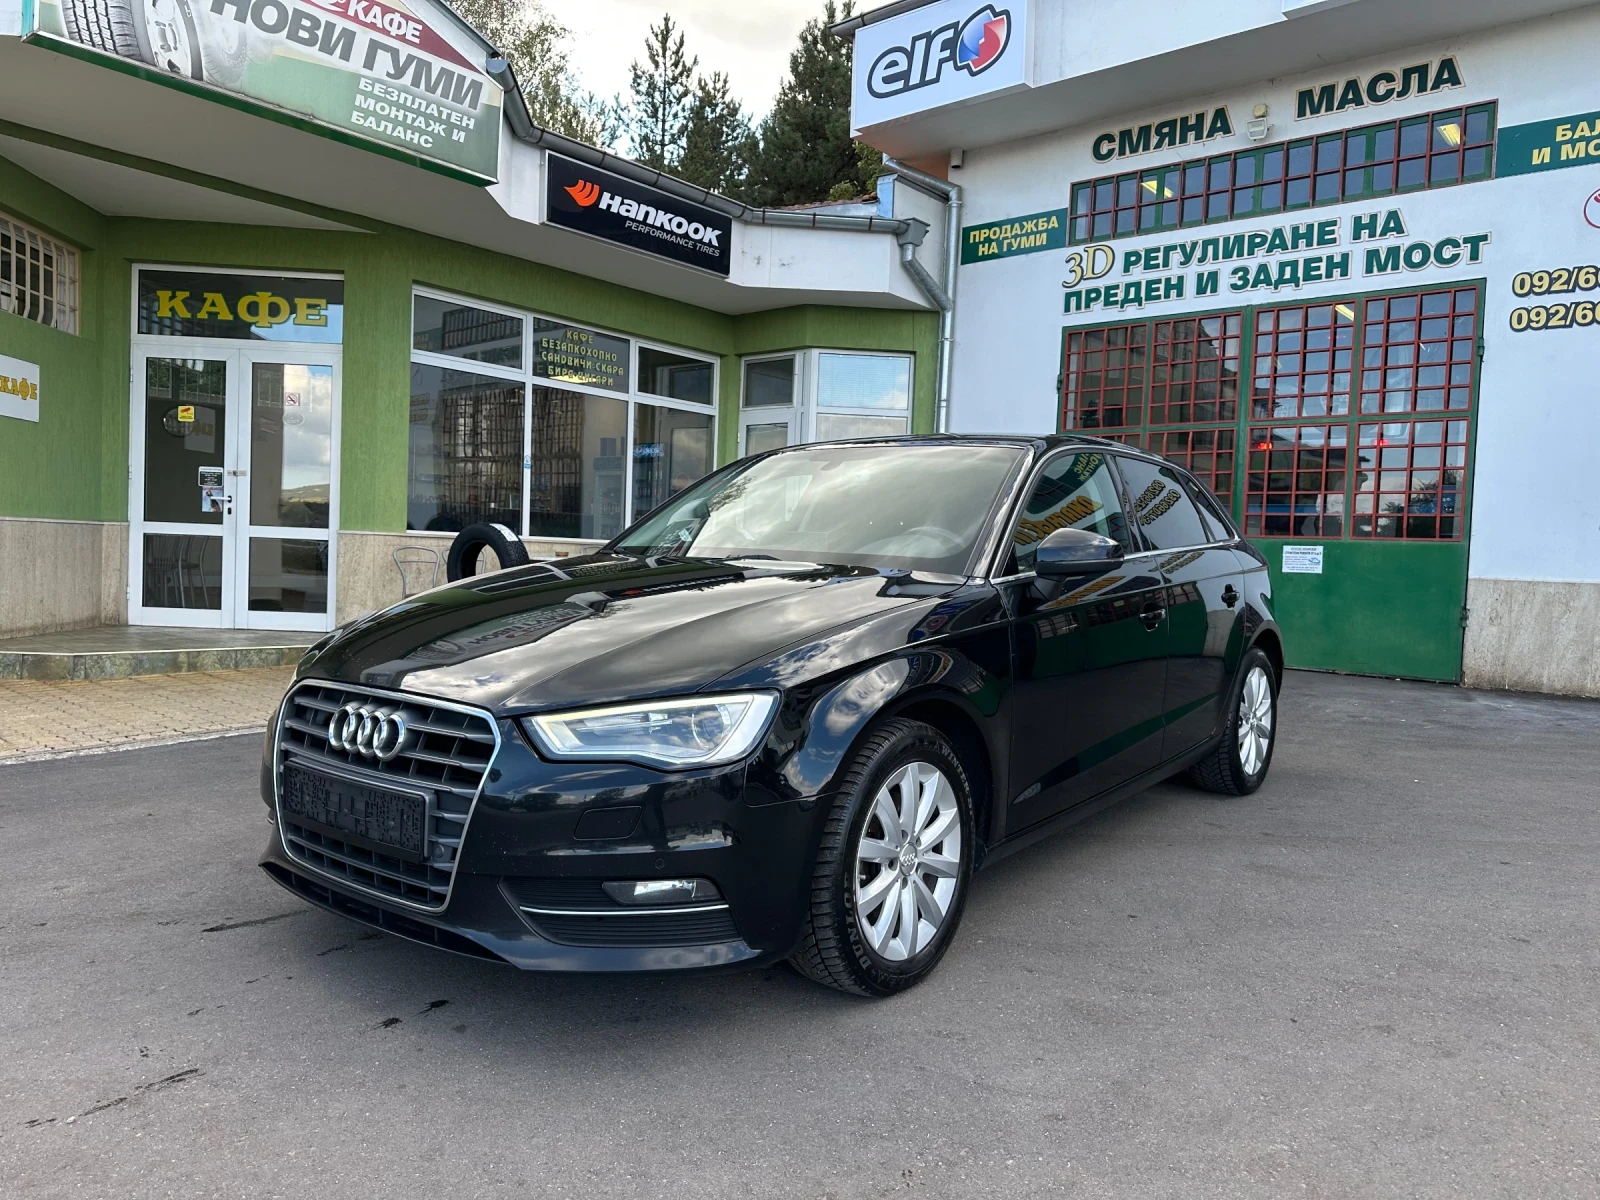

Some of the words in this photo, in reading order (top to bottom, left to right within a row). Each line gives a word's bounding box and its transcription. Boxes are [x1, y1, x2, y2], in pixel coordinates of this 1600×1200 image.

[347, 0, 423, 44] КАФЕ
[362, 38, 483, 111] ГУМИ
[867, 21, 960, 98] elf
[354, 93, 446, 137] МОНТАЖ
[452, 128, 466, 144] И
[358, 77, 475, 130] БЕЗПЛАТЕН
[1092, 106, 1234, 162] СМЯНА
[1296, 56, 1464, 120] МАСЛА
[350, 110, 433, 149] БАЛАНС
[1531, 146, 1551, 165] И
[625, 220, 694, 249] PERFORMANCE
[696, 243, 721, 257] TIRES
[969, 215, 1059, 244] ПРОДАЖБА
[978, 241, 998, 257] НА
[1003, 232, 1047, 252] ГУМИ
[1062, 244, 1115, 288] 3D
[1122, 218, 1339, 274] РЕГУЛИРАНЕ
[1351, 209, 1405, 242] НА
[1063, 274, 1185, 313] ПРЕДЕН
[1195, 270, 1220, 296] И
[1229, 252, 1350, 291] ЗАДЕН
[1365, 234, 1489, 274] МОСТ
[1512, 265, 1600, 298] 092/6
[156, 290, 328, 328] КАФЕ
[567, 329, 593, 344] КАФЕ
[0, 375, 38, 400] КАФЕ
